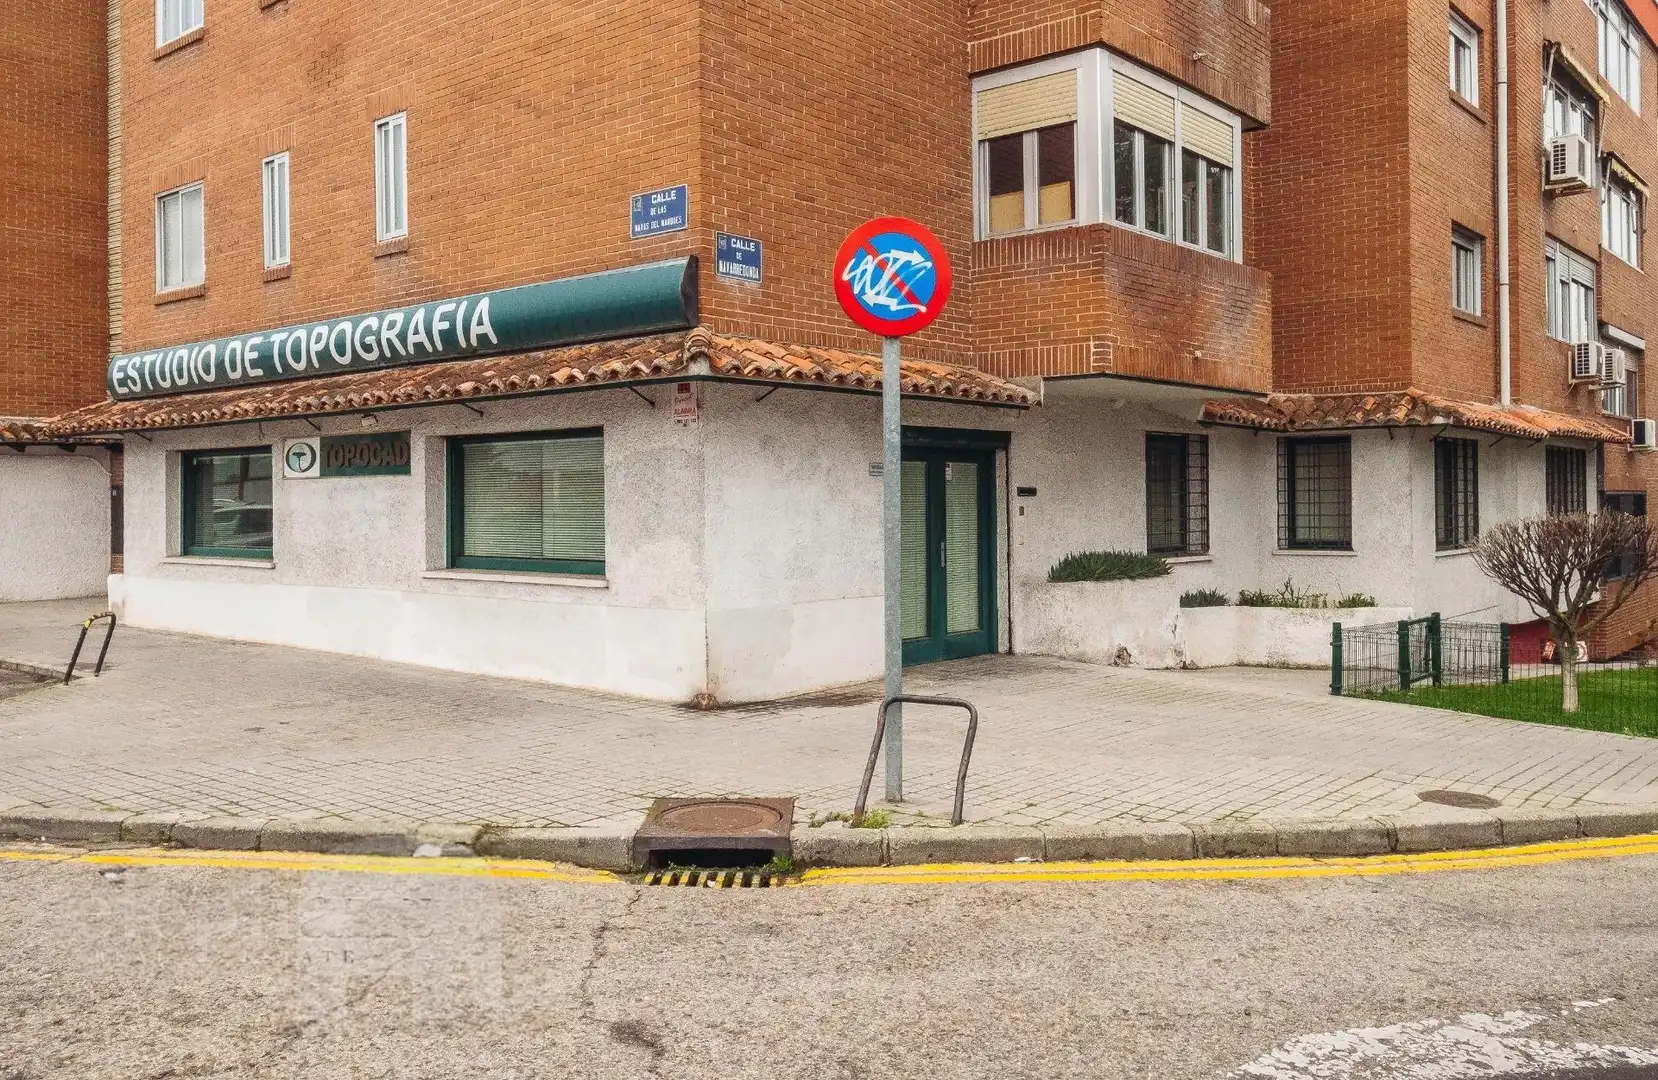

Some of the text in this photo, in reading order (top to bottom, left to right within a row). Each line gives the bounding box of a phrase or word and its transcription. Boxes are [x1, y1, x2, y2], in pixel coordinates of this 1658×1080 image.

[651, 190, 677, 204] CALLE
[650, 205, 667, 216] DE LAS
[651, 220, 660, 229] DEL
[731, 238, 756, 252] CALLE
[735, 251, 743, 261] DE
[718, 259, 759, 279] NAVARREDONDA
[112, 296, 498, 394] ESTUDIO DE TOPOGRAFIA
[323, 440, 411, 468] TOPOCAD
